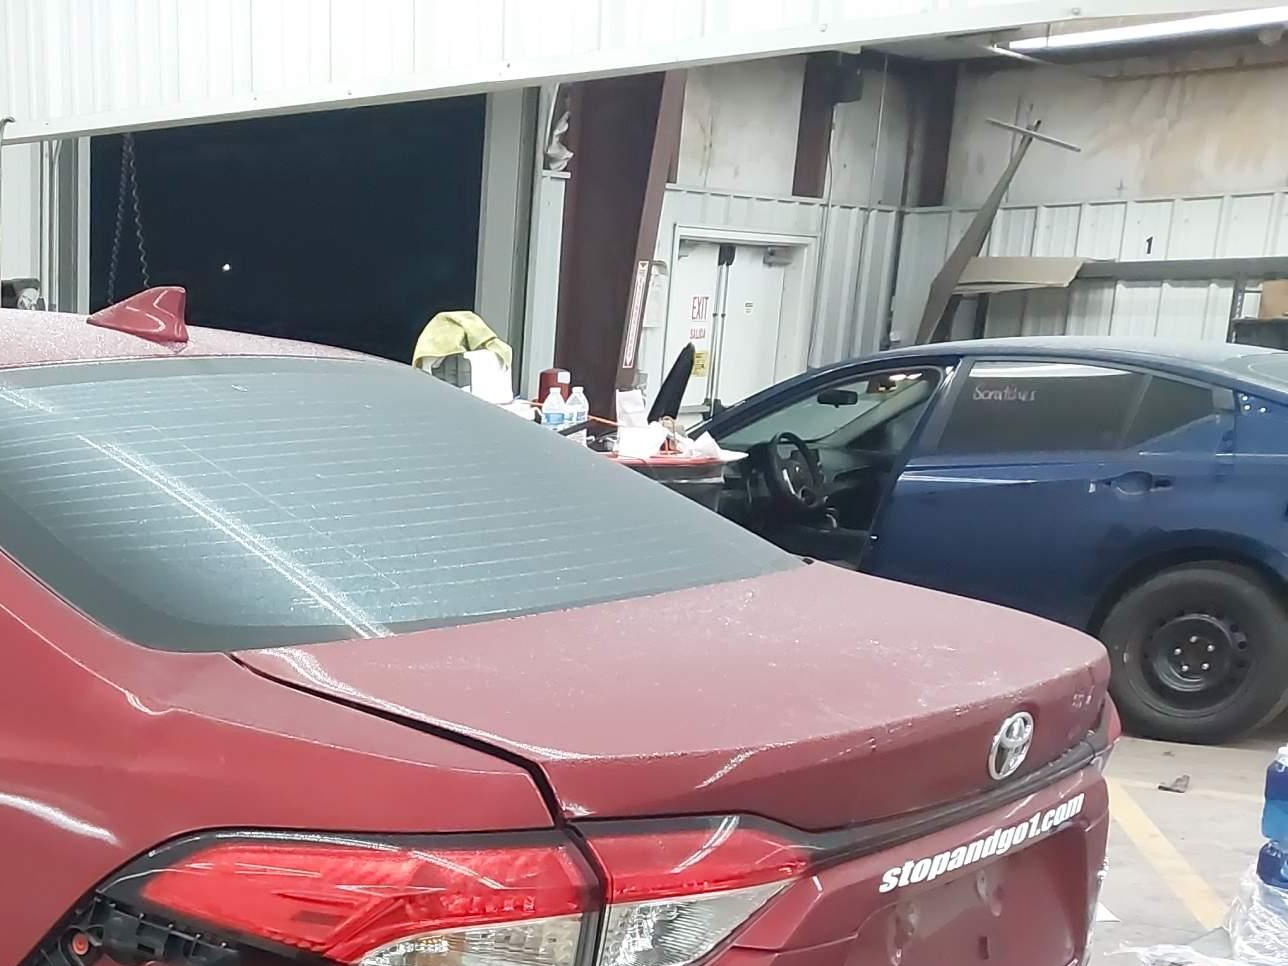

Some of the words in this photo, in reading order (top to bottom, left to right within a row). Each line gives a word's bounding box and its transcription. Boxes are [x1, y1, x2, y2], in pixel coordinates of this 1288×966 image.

[1146, 236, 1153, 254] 1
[692, 296, 709, 320] EXIT
[878, 793, 1085, 893] stopandgo1.com
